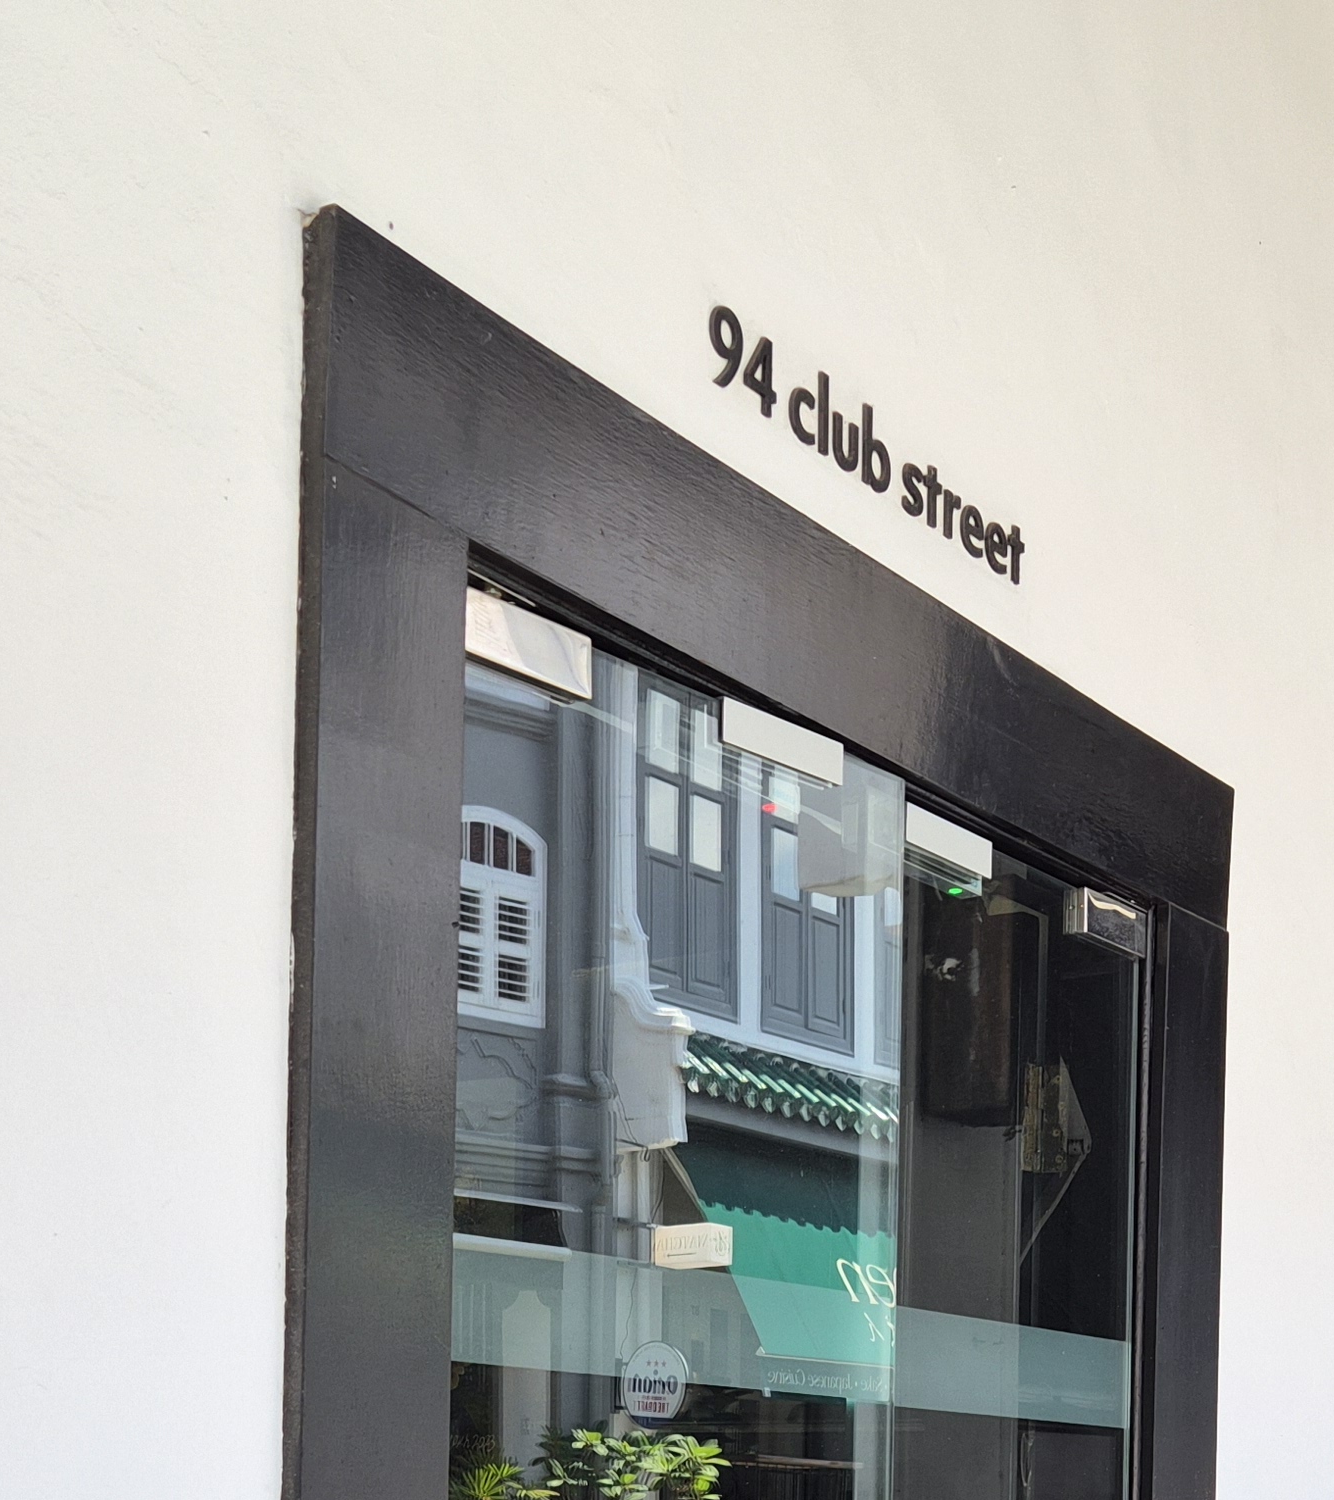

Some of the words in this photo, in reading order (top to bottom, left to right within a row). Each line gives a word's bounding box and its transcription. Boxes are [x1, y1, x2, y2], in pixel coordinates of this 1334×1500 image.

[709, 305, 777, 418] 94
[788, 370, 891, 493] club
[901, 462, 1025, 585] street
